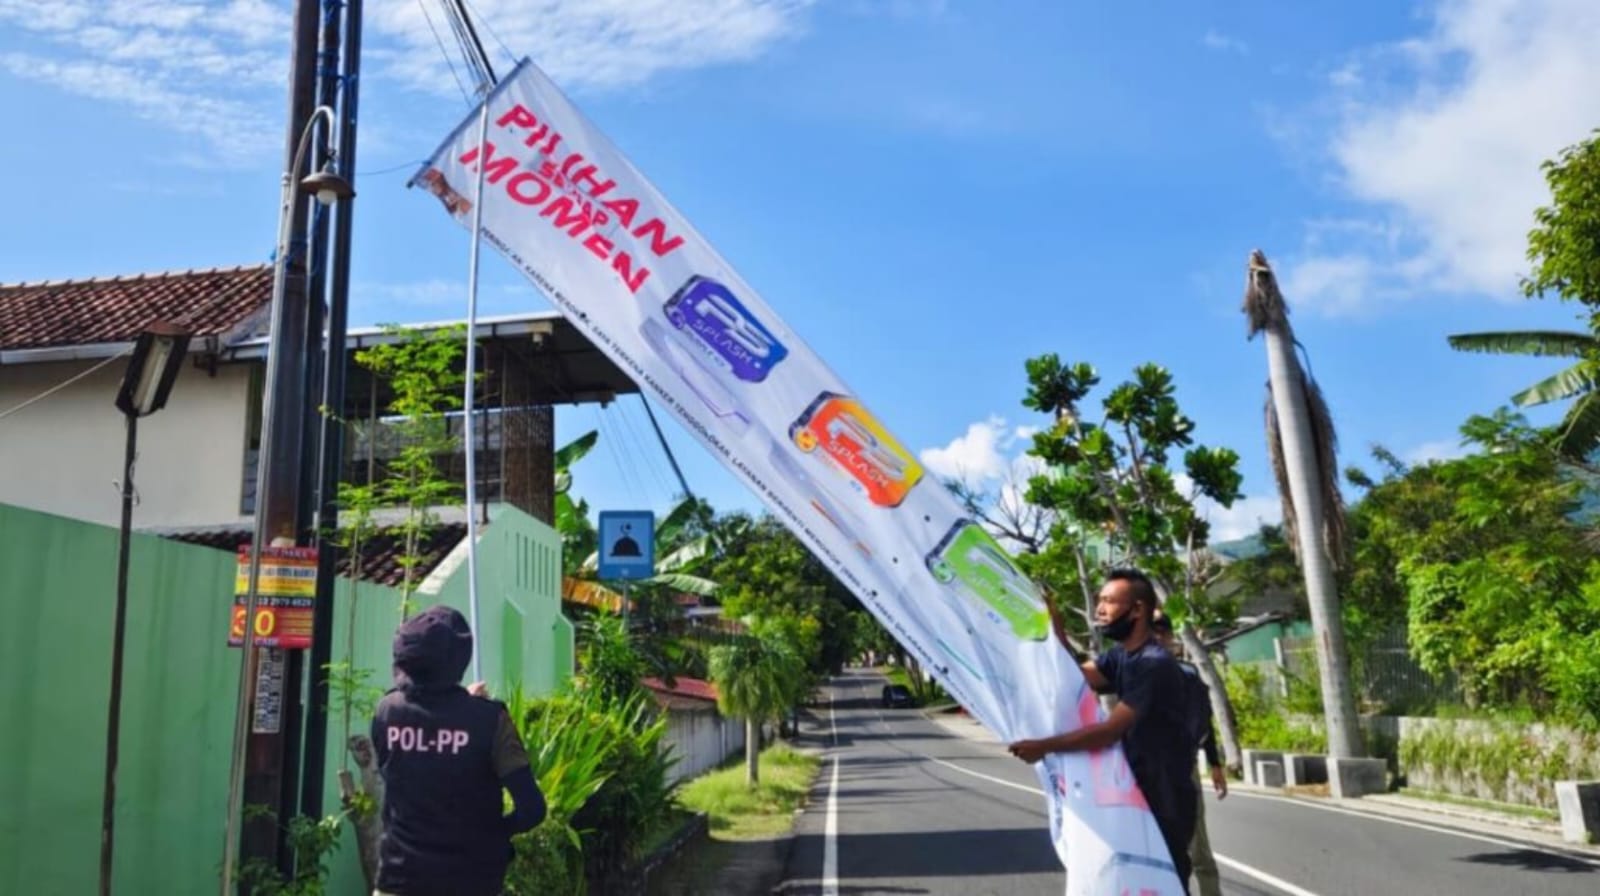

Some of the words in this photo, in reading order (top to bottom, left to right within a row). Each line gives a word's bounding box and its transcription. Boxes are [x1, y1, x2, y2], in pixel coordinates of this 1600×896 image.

[459, 141, 651, 293] MOMEN
[691, 318, 754, 366] SPLASH
[523, 264, 555, 294] KARENA
[552, 290, 593, 326] MEROKK,
[591, 324, 613, 344] SAYA
[609, 341, 646, 376] TERKENA
[642, 373, 676, 405] KANKER
[730, 456, 768, 492] LAYANAN
[828, 438, 890, 488] SPLASH
[387, 726, 469, 754] POL-PP
